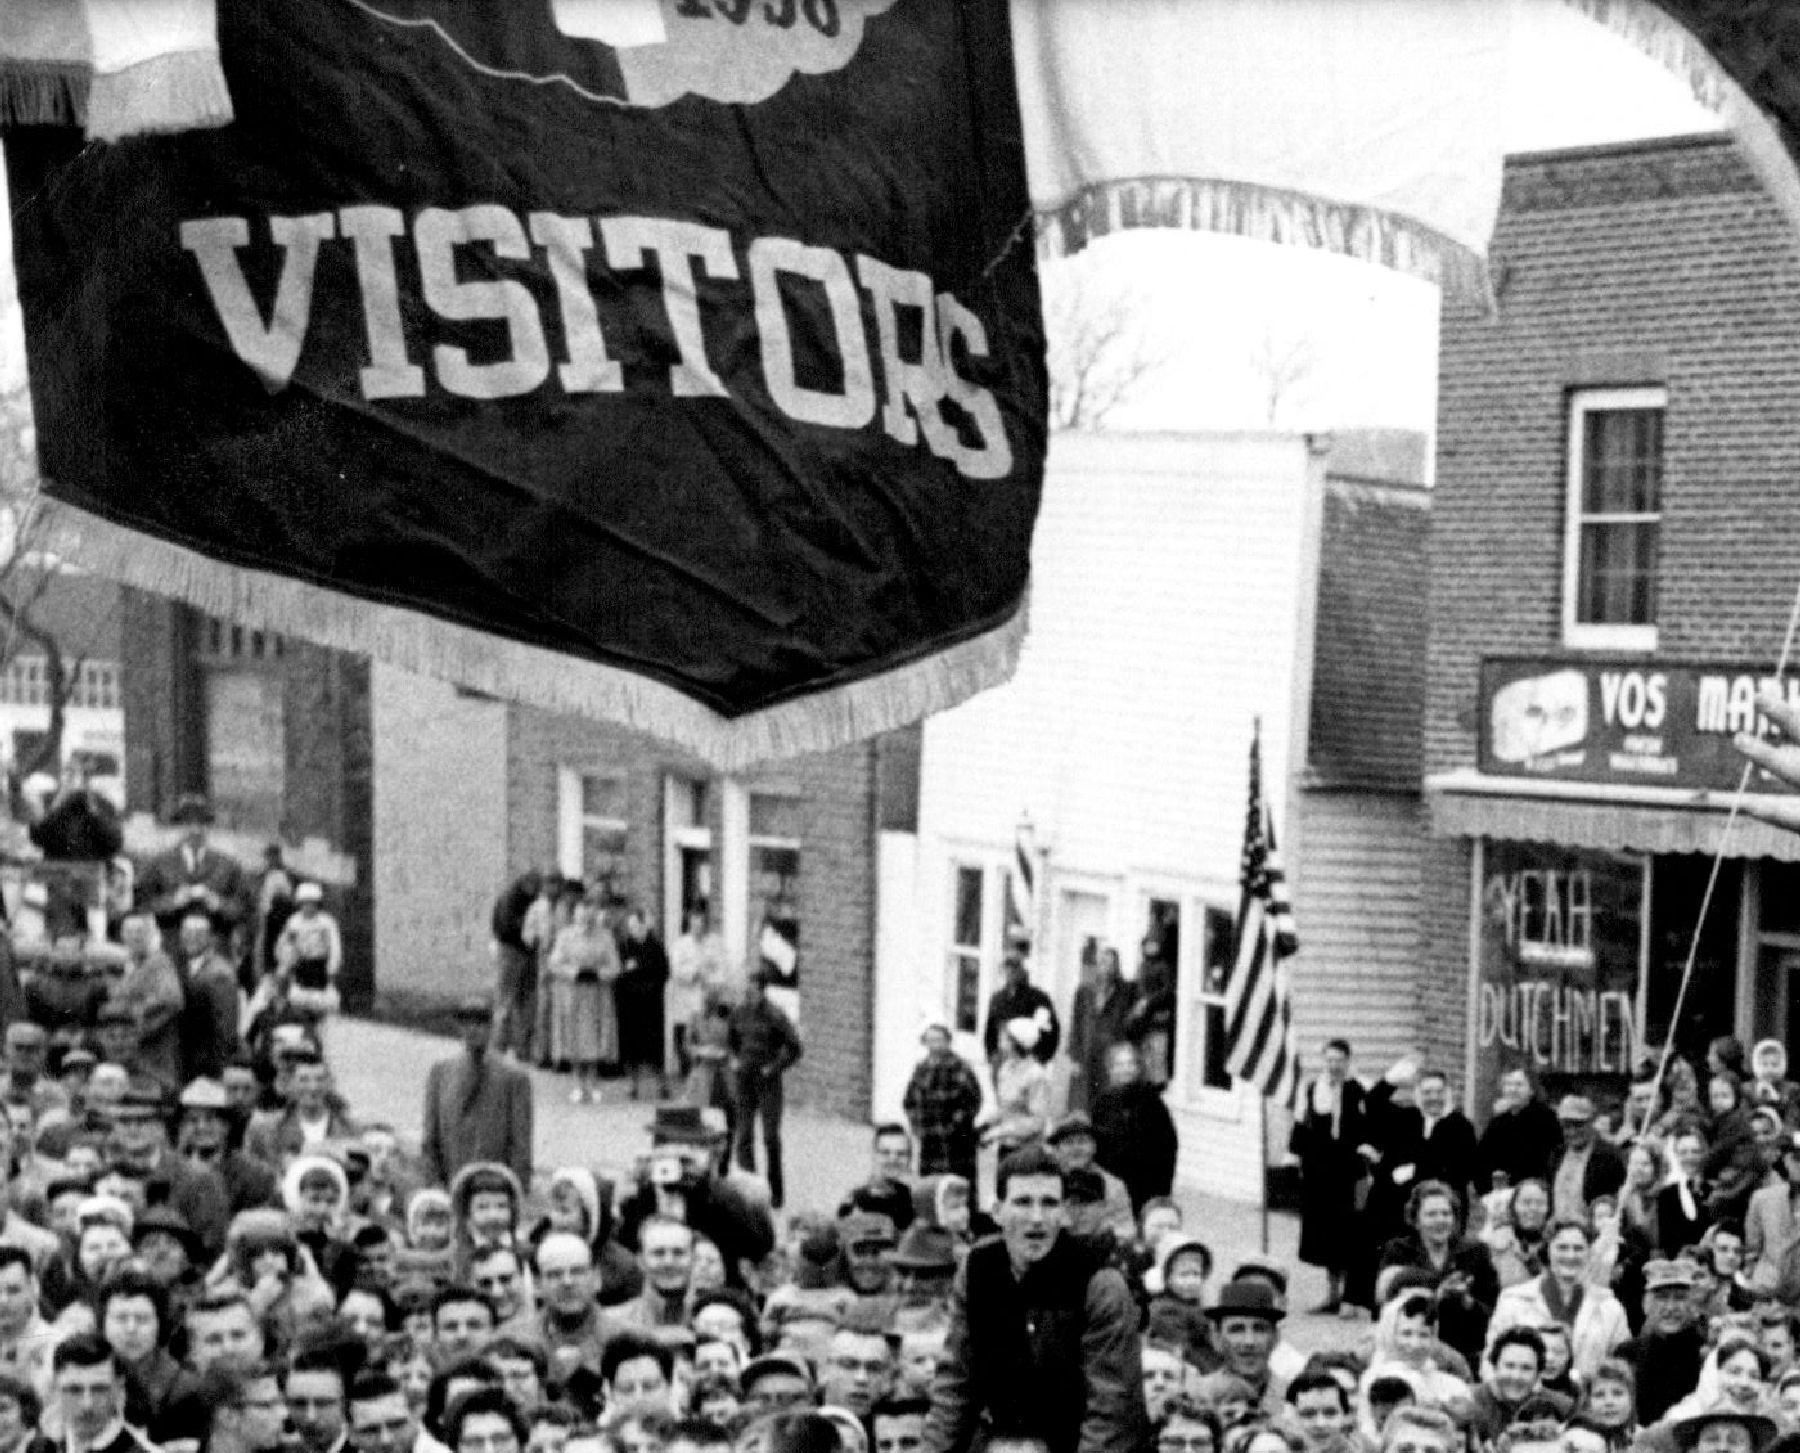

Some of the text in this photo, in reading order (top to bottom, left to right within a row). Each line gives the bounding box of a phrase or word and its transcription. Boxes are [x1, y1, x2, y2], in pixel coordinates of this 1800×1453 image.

[180, 205, 1013, 479] VISITORS
[1600, 671, 1668, 728] VOS
[1486, 868, 1595, 949] YEAH
[1479, 981, 1643, 1076] DUTCHMEN
